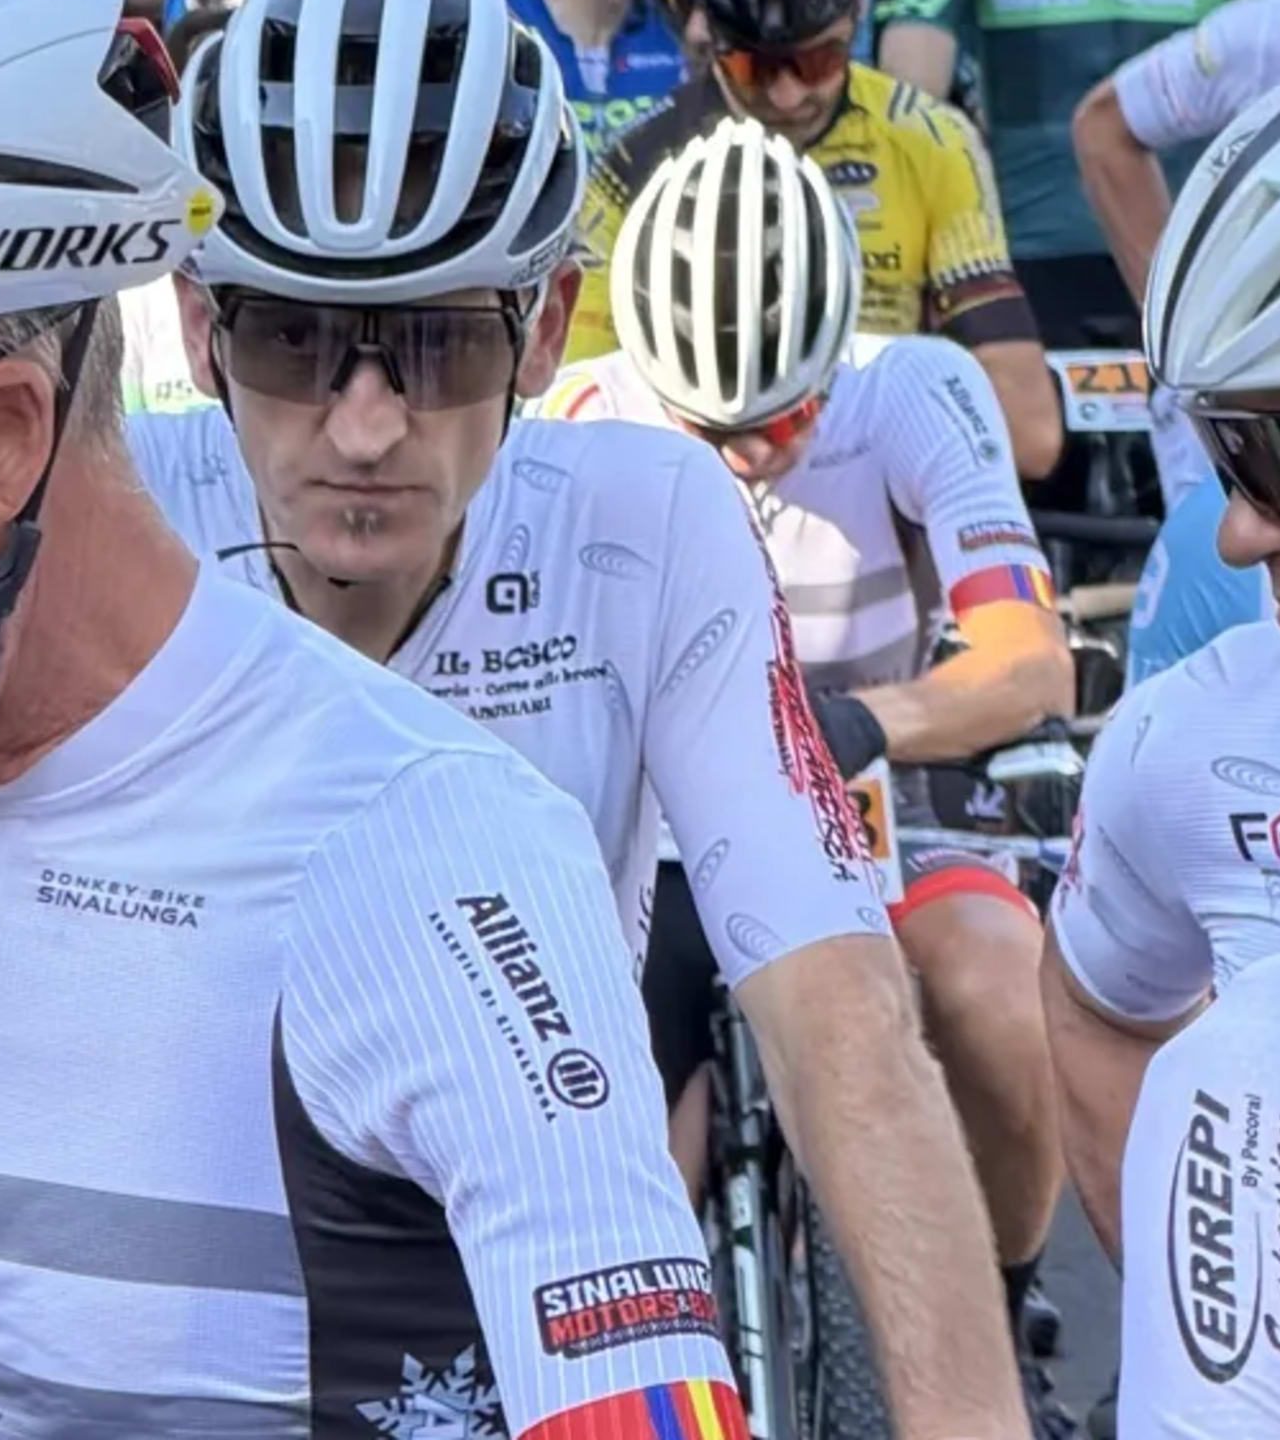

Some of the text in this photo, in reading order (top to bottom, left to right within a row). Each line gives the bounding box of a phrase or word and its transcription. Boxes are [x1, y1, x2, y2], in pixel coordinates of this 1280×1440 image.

[36, 885, 199, 929] SINALUNGA
[455, 891, 573, 1043] Allianz
[1186, 1088, 1238, 1352] ERREPI
[1240, 1162, 1263, 1188] By
